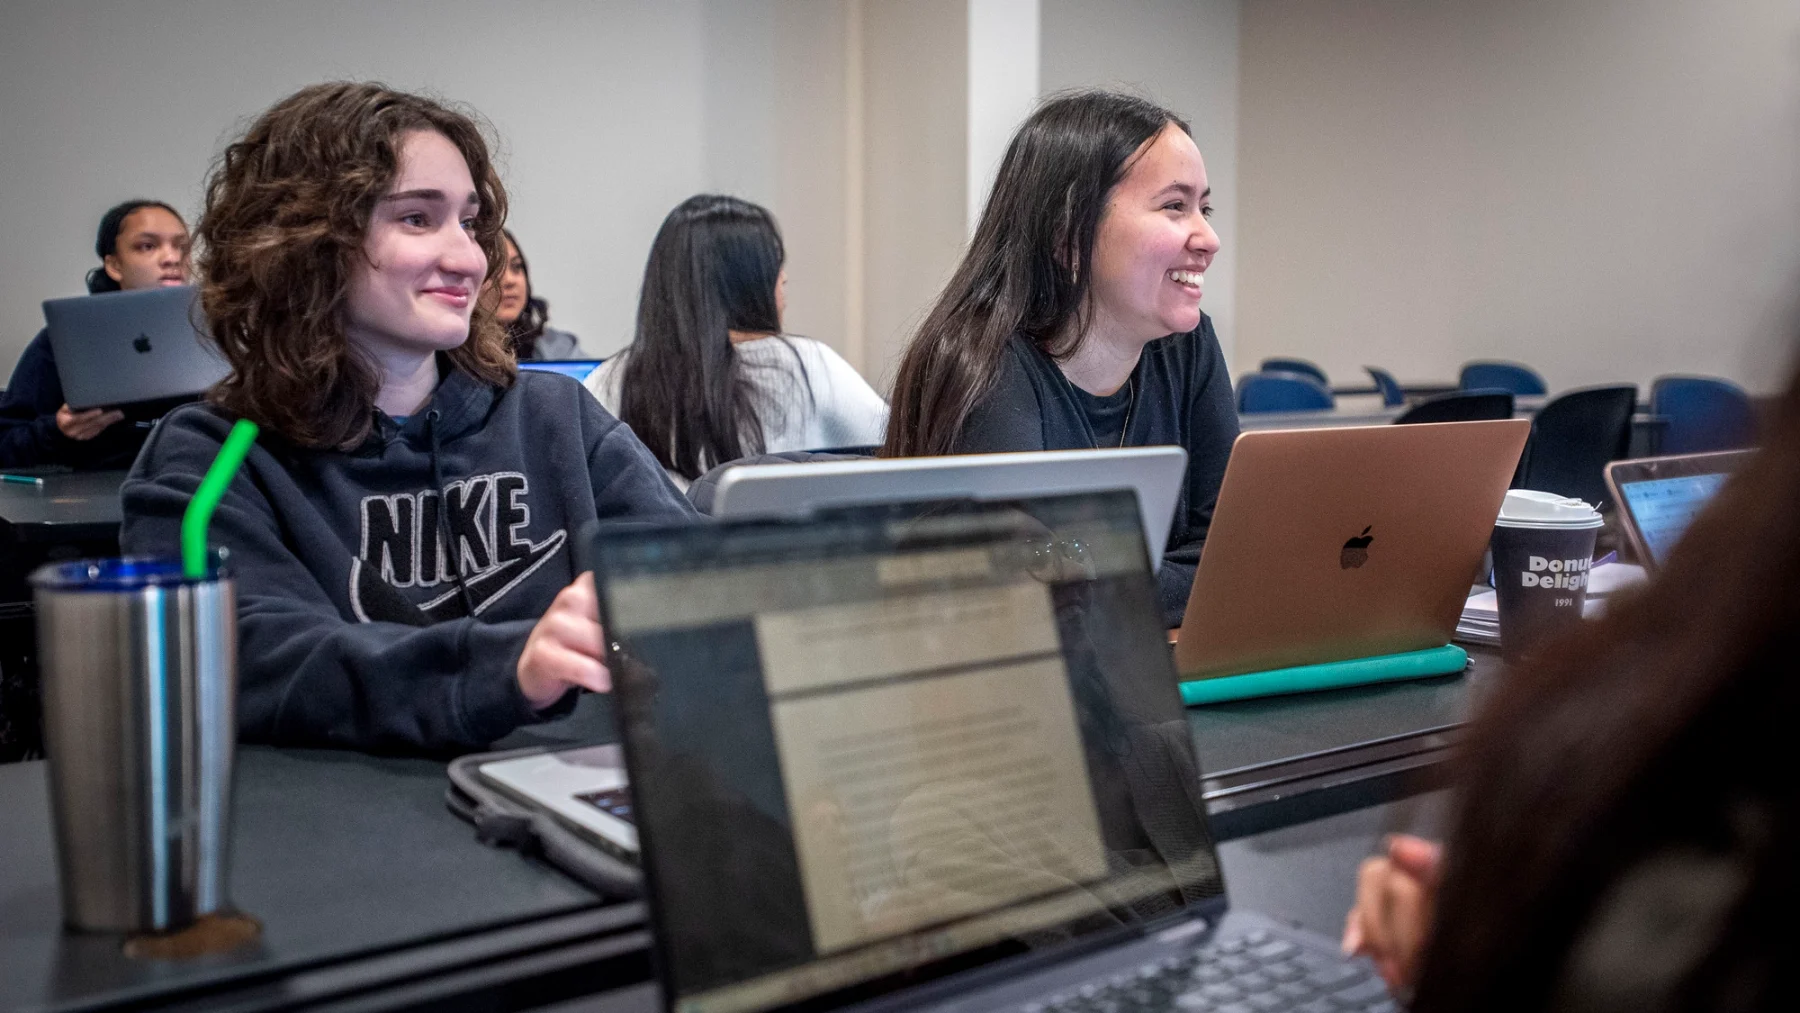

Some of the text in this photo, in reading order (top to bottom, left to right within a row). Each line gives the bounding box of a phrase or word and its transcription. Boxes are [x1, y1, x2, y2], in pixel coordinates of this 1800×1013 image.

[360, 472, 532, 588] NIKE
[1521, 571, 1589, 591] Deligh
[1555, 598, 1573, 607] 1991
